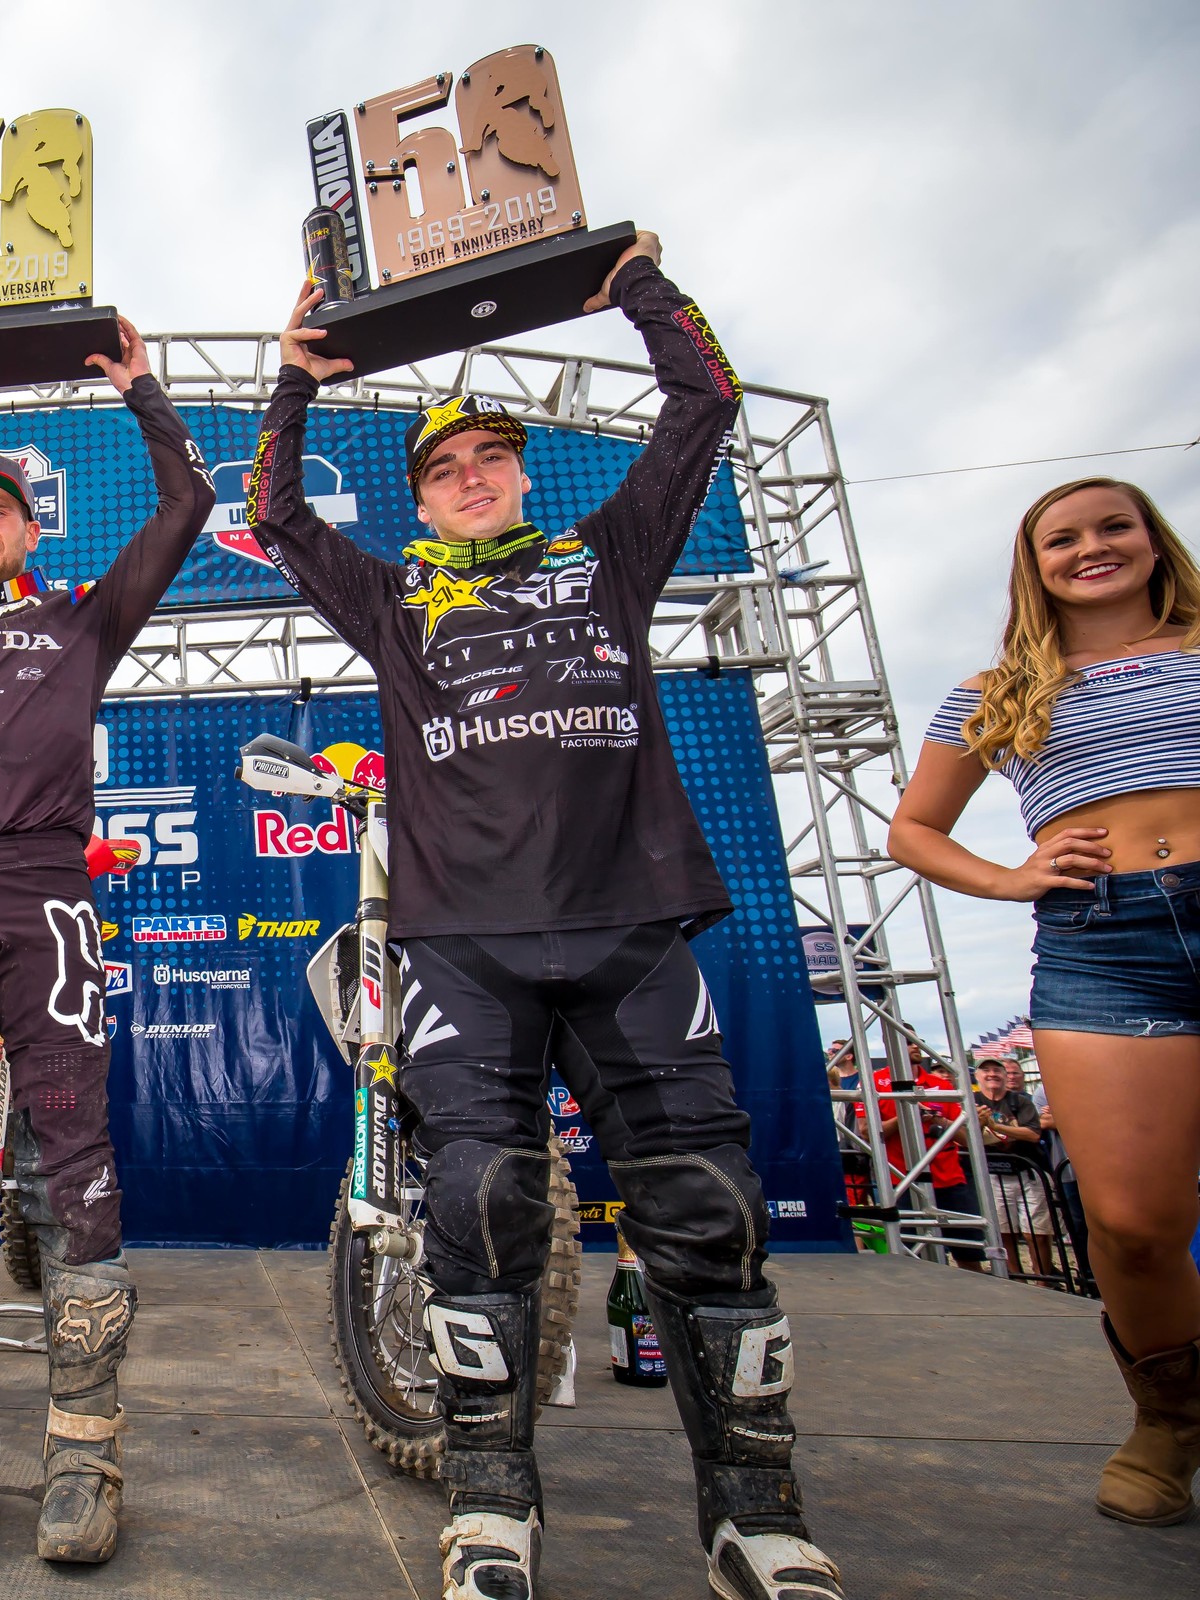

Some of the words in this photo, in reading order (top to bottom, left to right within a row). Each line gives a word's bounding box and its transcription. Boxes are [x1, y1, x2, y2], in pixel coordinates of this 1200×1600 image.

[397, 185, 557, 258] 1969-2019
[412, 247, 445, 267] 50TH
[453, 216, 544, 255] ANNIVERSARY
[706, 360, 734, 400] DRINK
[427, 646, 471, 671] FLY
[451, 665, 523, 686] SCOSCHE
[459, 705, 639, 749] Husqvarna
[560, 739, 606, 748] FACTORY
[254, 807, 351, 857] Red
[133, 915, 226, 933] PARTS
[256, 919, 321, 938] THOR
[134, 930, 226, 942] UNLIMITED
[814, 942, 836, 953] SS
[172, 967, 250, 985] Husqvarna
[145, 1023, 216, 1034] DUNLOP
[354, 1114, 368, 1198] MOTOREX
[372, 1091, 388, 1200] DUNLOP
[779, 1201, 806, 1211] PRO
